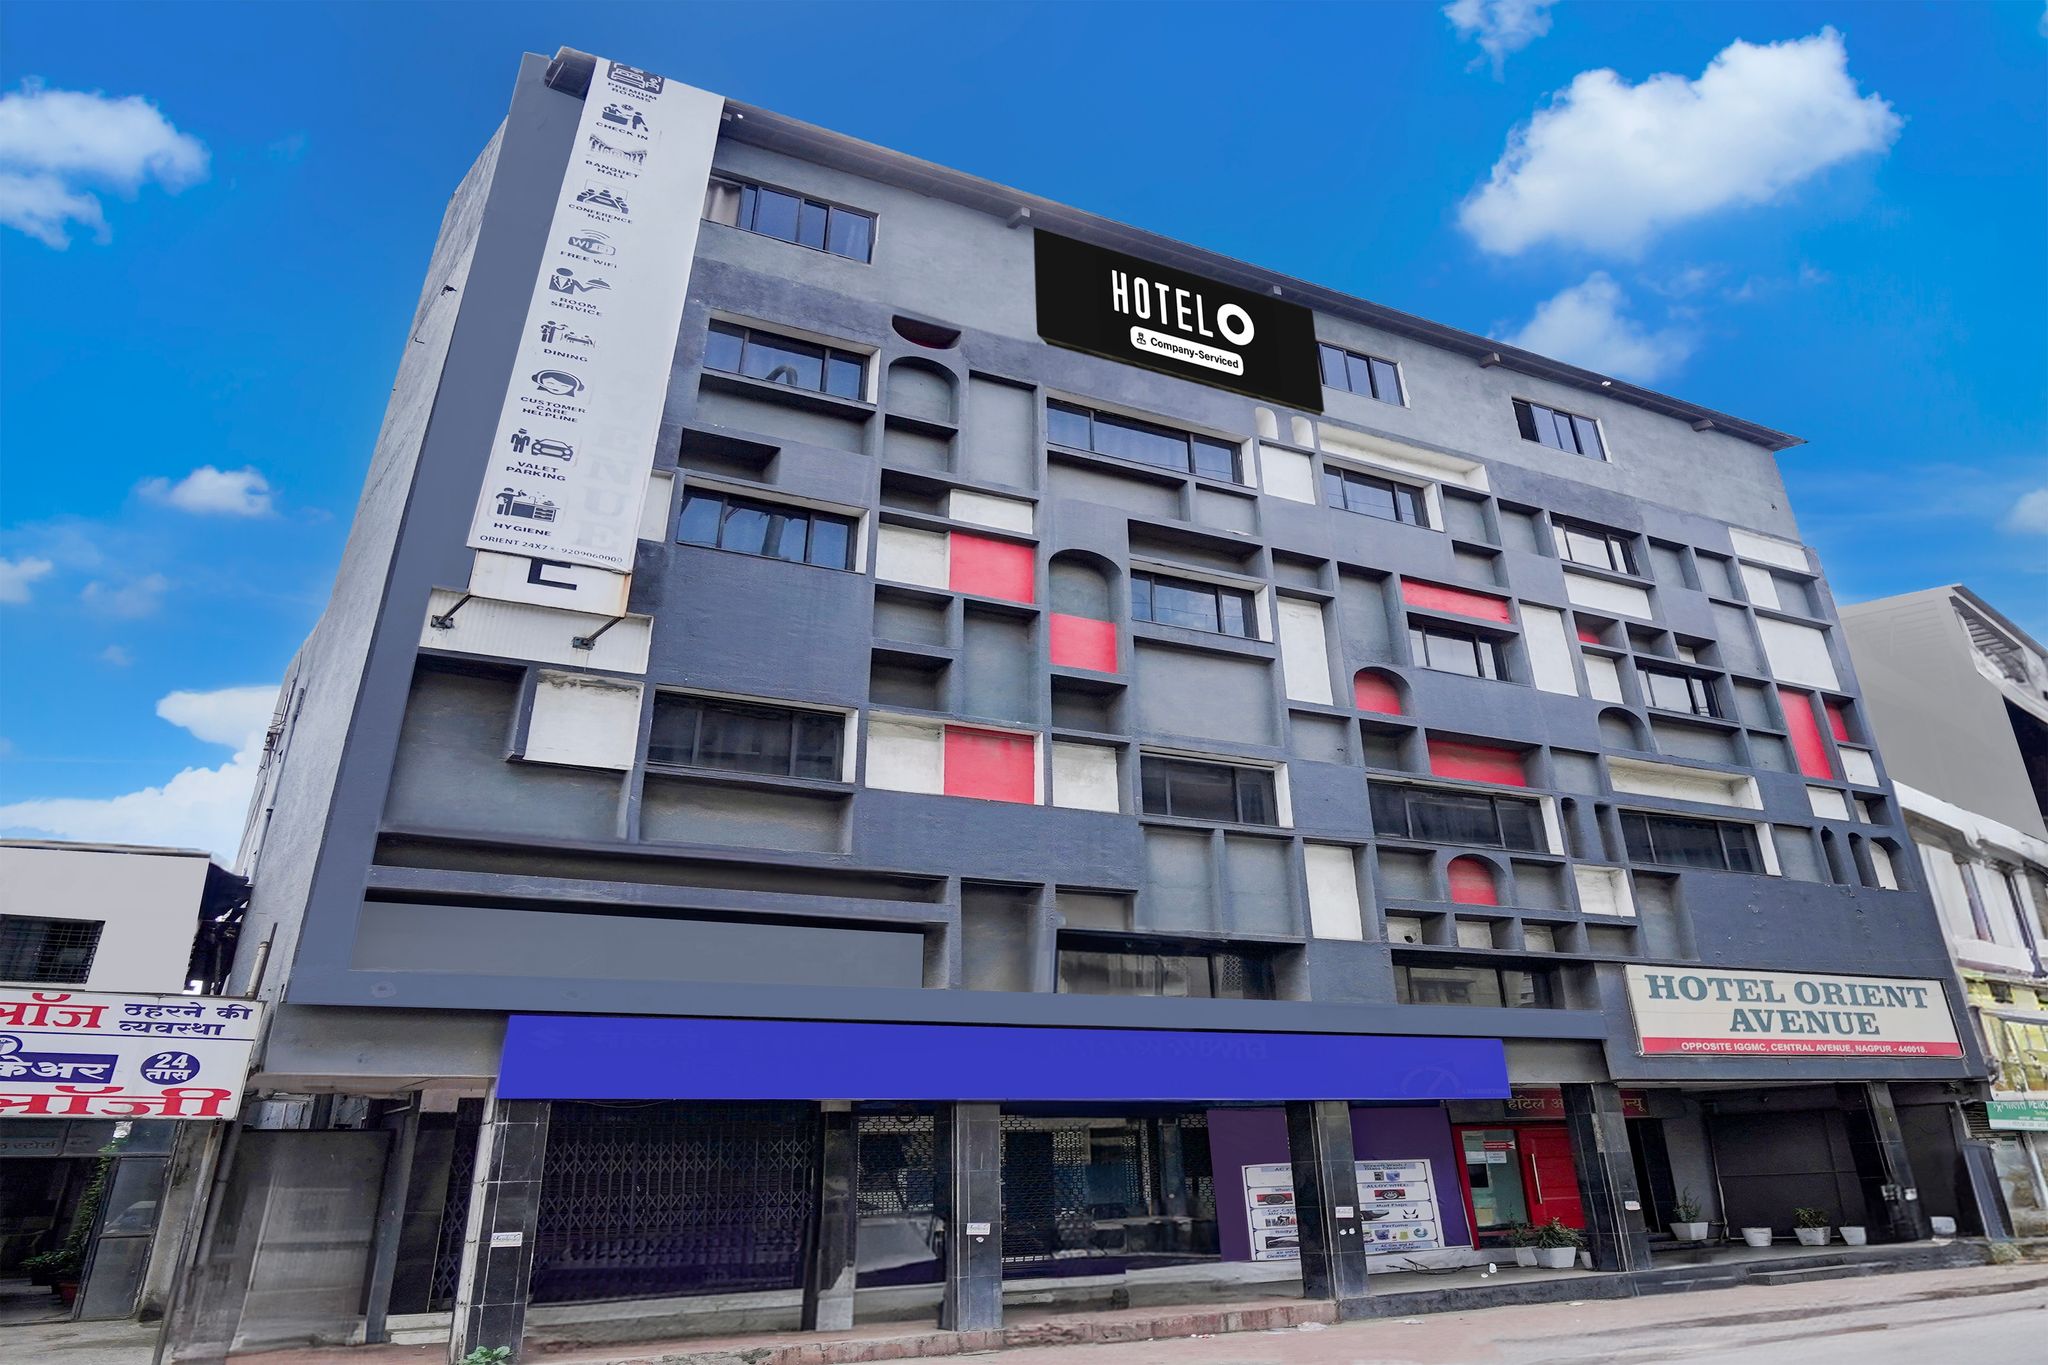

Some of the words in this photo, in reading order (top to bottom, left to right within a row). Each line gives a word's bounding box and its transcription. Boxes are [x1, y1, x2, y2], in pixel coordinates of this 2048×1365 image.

[607, 82, 657, 100] PREMIUM
[612, 88, 651, 103] ROOMS
[596, 121, 633, 137] CHECK
[586, 160, 639, 178] BANQUET
[597, 168, 625, 179] HALL
[568, 203, 633, 224] CONFERENCE
[587, 213, 612, 223] HALL
[560, 250, 590, 261] FREE
[551, 300, 602, 316] SERVICE
[559, 297, 597, 310] ROOM
[543, 348, 588, 362] DINING
[1150, 336, 1239, 370] Company-Serviced
[520, 396, 586, 414] CUSTOMER
[536, 405, 568, 416] CARE
[522, 408, 578, 423] HELPLINE
[505, 466, 567, 482] PARKING
[518, 461, 559, 473] VALET
[493, 522, 552, 537] HYGIENE
[479, 534, 520, 546] ORIENT
[521, 541, 548, 551] 24X7
[1644, 974, 1787, 1003] HOTEL
[1793, 980, 1928, 1009] ORIENT
[123, 1001, 207, 1020] ठहरने
[216, 1003, 254, 1020] की
[118, 1020, 226, 1036] व्यवस्था
[1729, 1008, 1881, 1036] AVENUE
[1681, 1041, 1732, 1051] OPPOSITE
[1734, 1043, 1769, 1052] IGGMC,
[1770, 1043, 1815, 1052] CENTRAL
[1815, 1043, 1854, 1053] AVENUE,
[1855, 1044, 1892, 1053] NAGPUR
[154, 1053, 189, 1069] 24
[145, 1068, 192, 1081] तास
